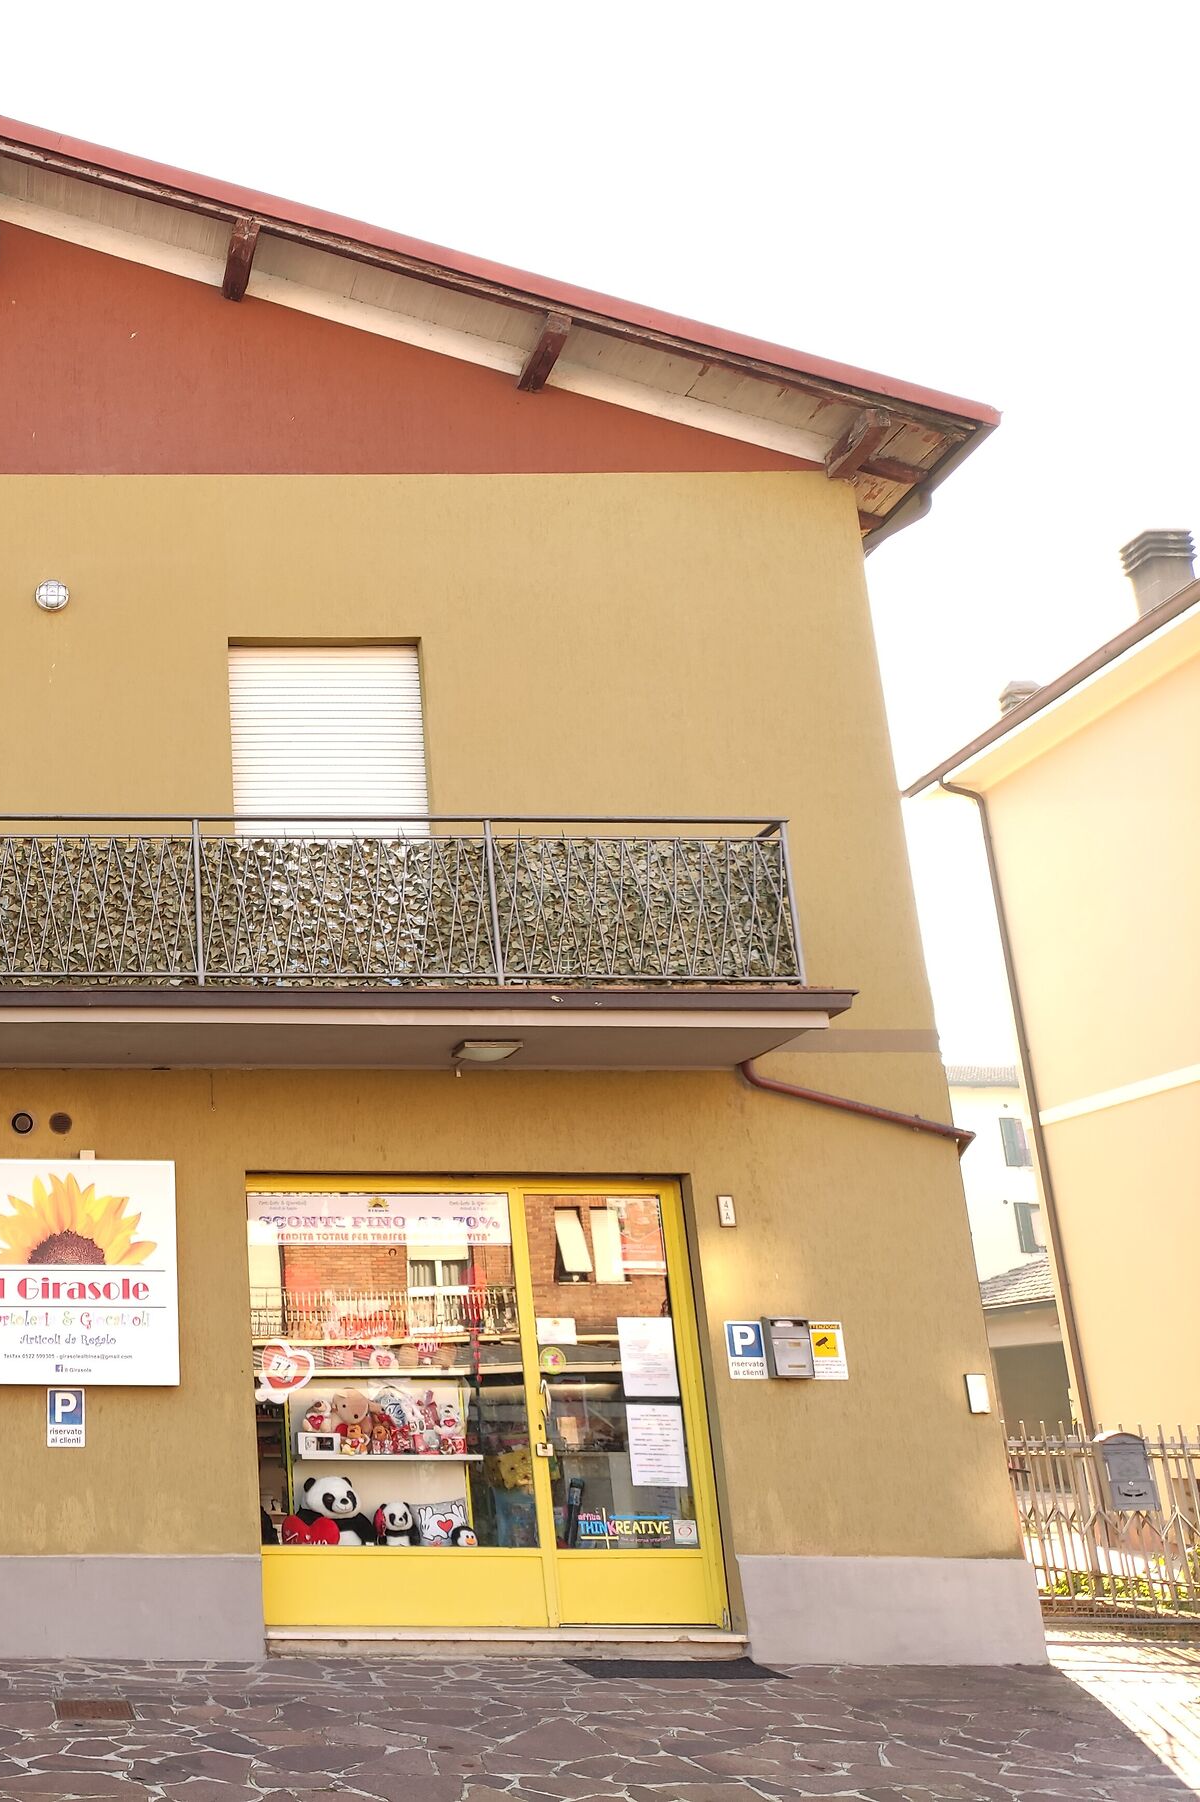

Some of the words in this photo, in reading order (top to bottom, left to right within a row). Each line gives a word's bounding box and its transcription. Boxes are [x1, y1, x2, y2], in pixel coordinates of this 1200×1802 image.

[351, 1215, 406, 1229] FINO
[277, 1232, 314, 1241] ENDITA
[316, 1232, 349, 1241] TOTALE
[351, 1232, 368, 1241] PER
[16, 1276, 150, 1300] Girasole
[62, 1311, 75, 1326] &
[19, 1333, 61, 1345] Articoli
[64, 1334, 77, 1345] da
[80, 1333, 117, 1347] Regalo
[731, 1325, 756, 1356] P
[55, 1391, 77, 1422] P
[49, 1428, 82, 1436] riservato
[50, 1436, 58, 1444] ai
[59, 1436, 81, 1444] clienti
[578, 1520, 672, 1536] THINKREATIVE
